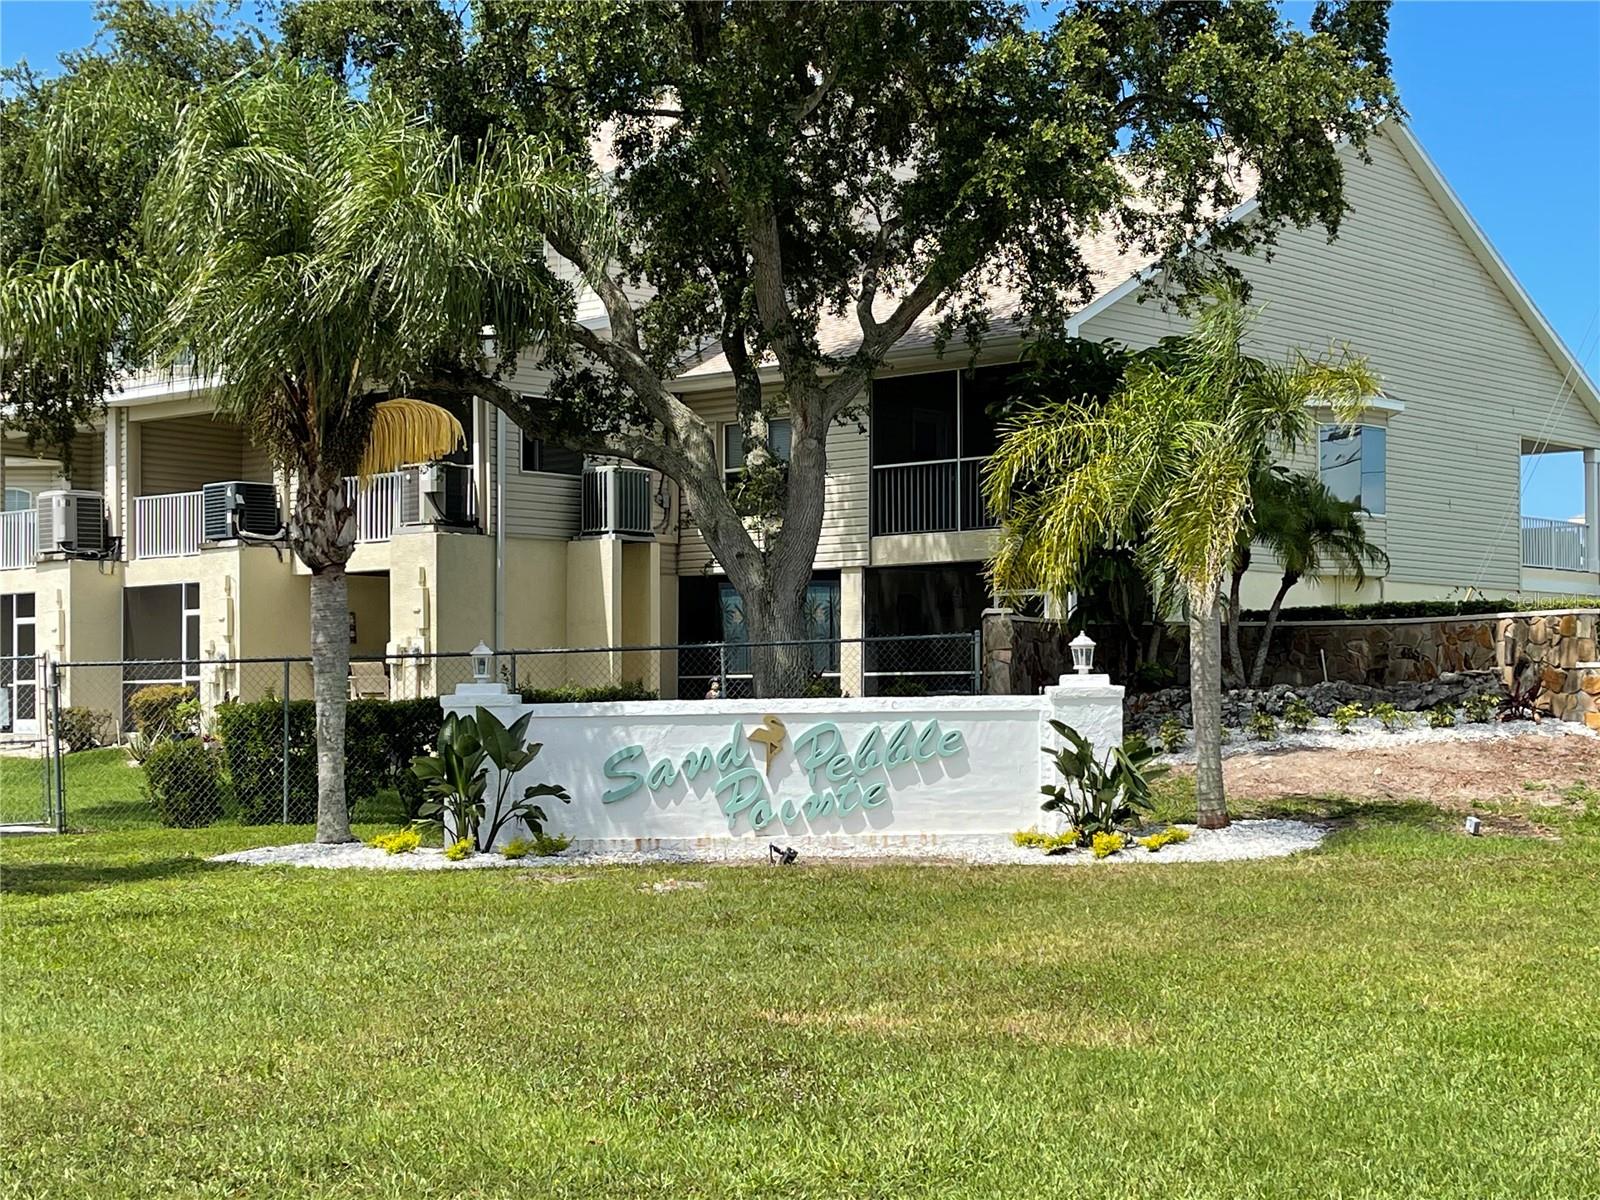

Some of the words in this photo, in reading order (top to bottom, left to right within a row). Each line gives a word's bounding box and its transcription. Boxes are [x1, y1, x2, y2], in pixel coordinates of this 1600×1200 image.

[603, 720, 748, 804] Sand
[793, 718, 965, 786] Pebble
[714, 767, 888, 831] Pointe
